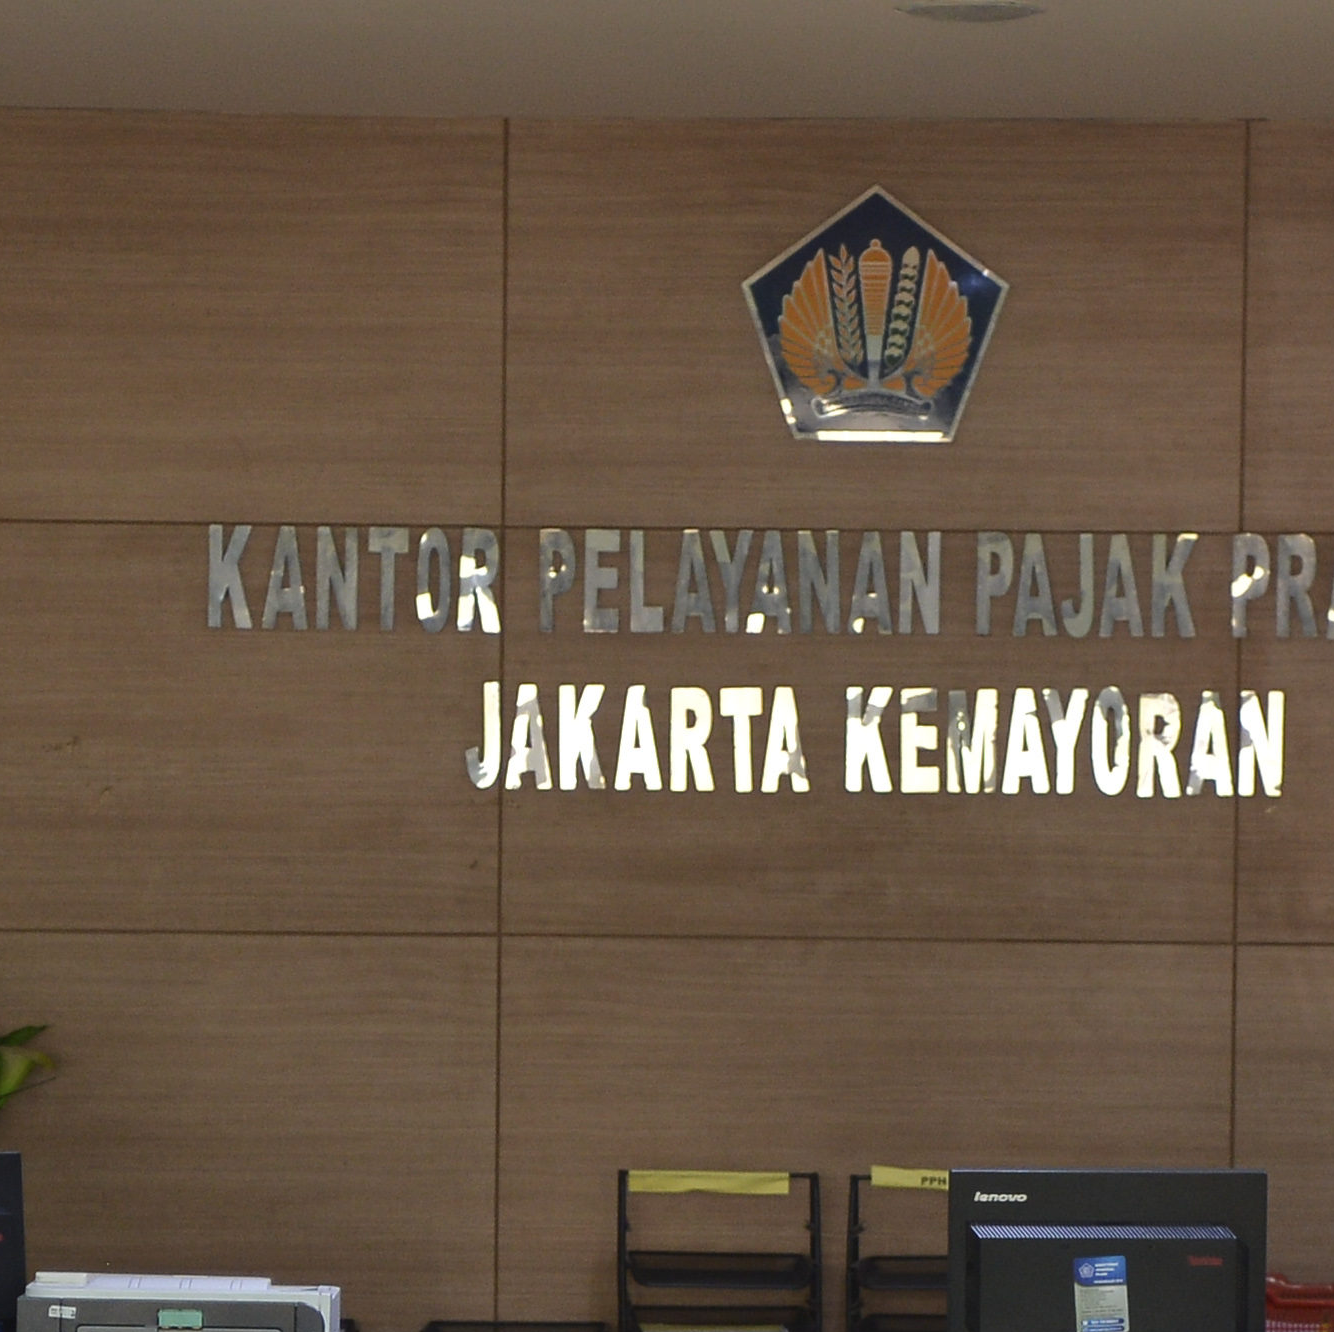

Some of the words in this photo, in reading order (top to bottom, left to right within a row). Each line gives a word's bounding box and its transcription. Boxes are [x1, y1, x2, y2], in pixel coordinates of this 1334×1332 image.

[207, 524, 501, 633] KANTOR
[539, 526, 941, 634] PELAYANAN
[976, 531, 1199, 638] PAJAK
[465, 681, 811, 792] JAKARTA
[845, 686, 1285, 798] KEMAYORAN
[921, 1176, 947, 1186] PPH
[974, 1191, 1028, 1203] lenovo
